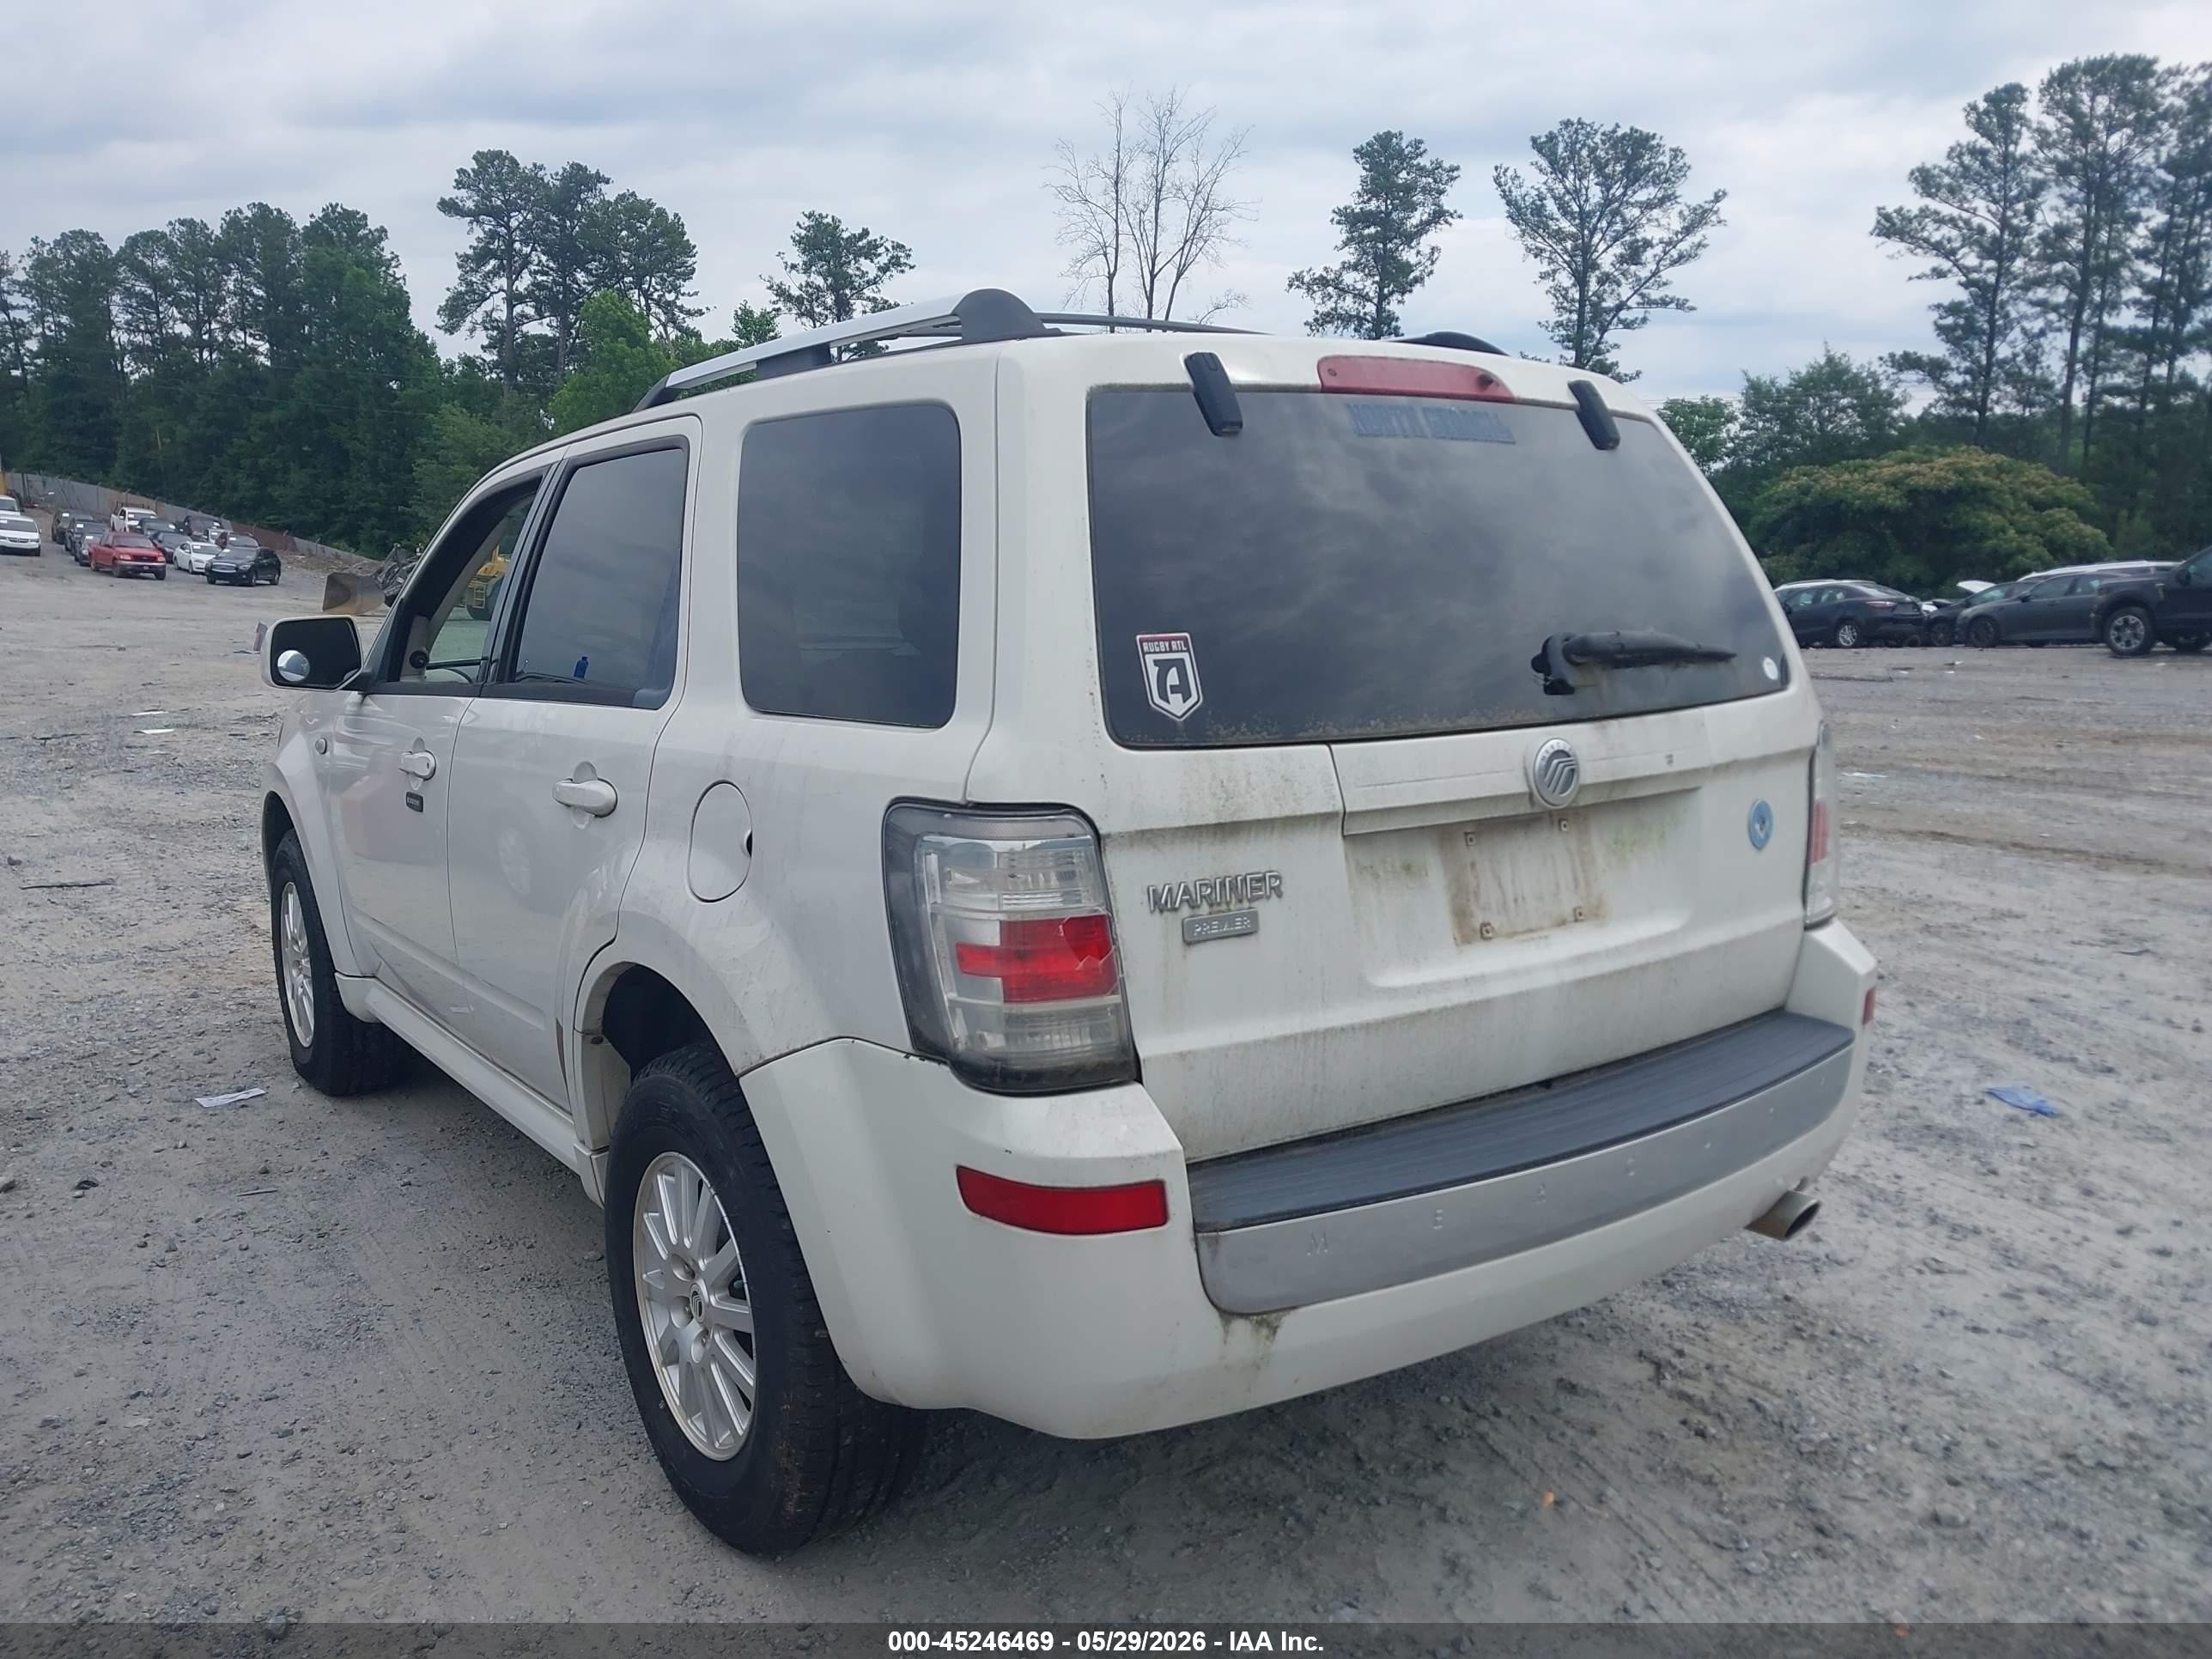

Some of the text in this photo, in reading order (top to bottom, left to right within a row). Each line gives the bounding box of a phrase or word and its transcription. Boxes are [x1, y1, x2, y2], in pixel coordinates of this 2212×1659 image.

[1142, 640, 1188, 653] RUGBY ATL
[1147, 870, 1283, 914] MARINER
